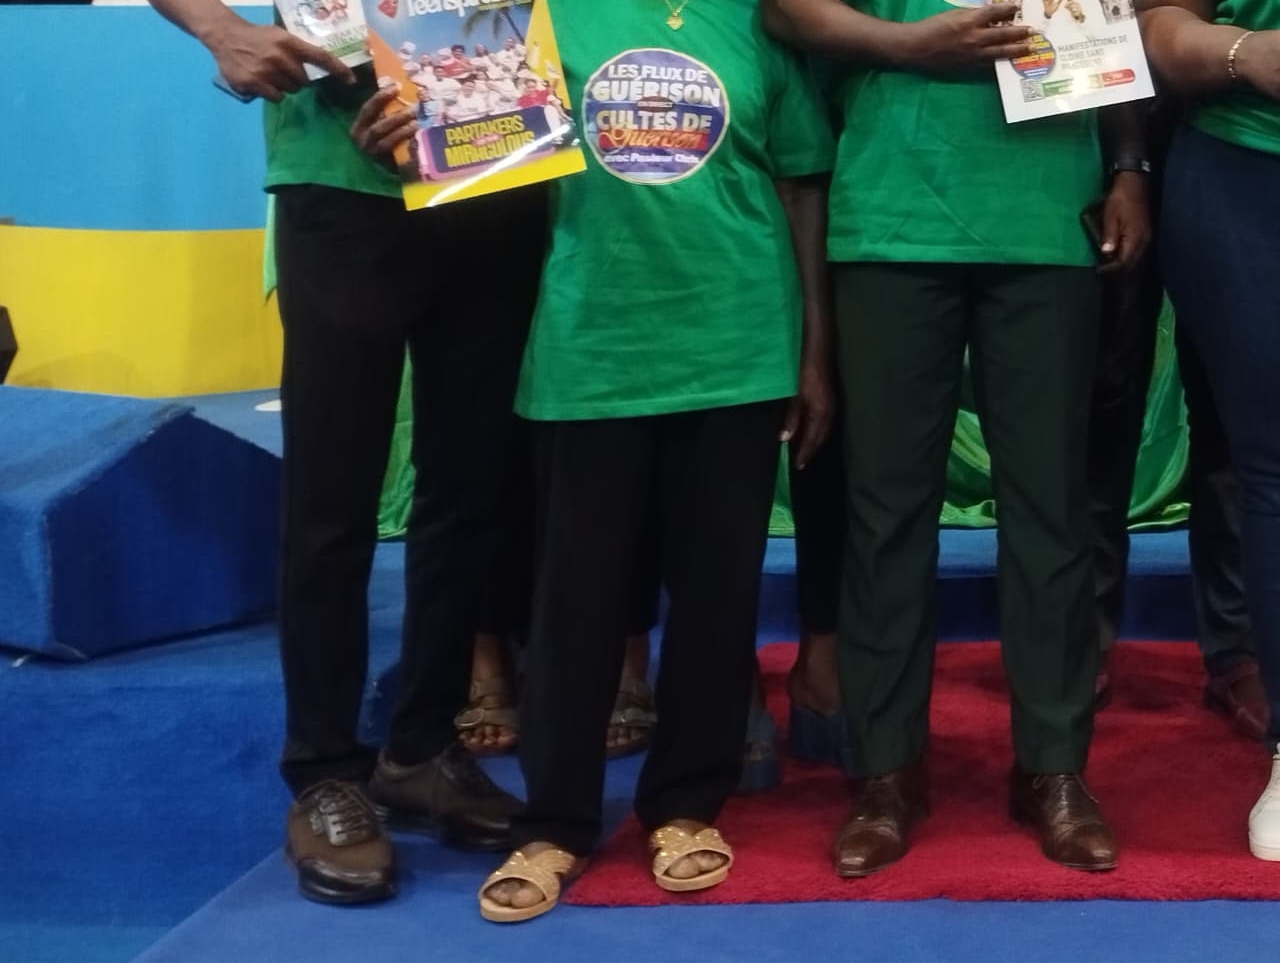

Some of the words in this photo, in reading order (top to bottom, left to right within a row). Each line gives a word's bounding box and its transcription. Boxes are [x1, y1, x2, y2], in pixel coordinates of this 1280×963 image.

[607, 64, 639, 79] LES
[641, 65, 682, 81] FLUX
[685, 68, 708, 83] DE
[591, 76, 721, 107] GUÉRISON
[445, 114, 526, 146] PARTAKERS
[596, 109, 678, 131] CULTES
[683, 111, 713, 132] DE
